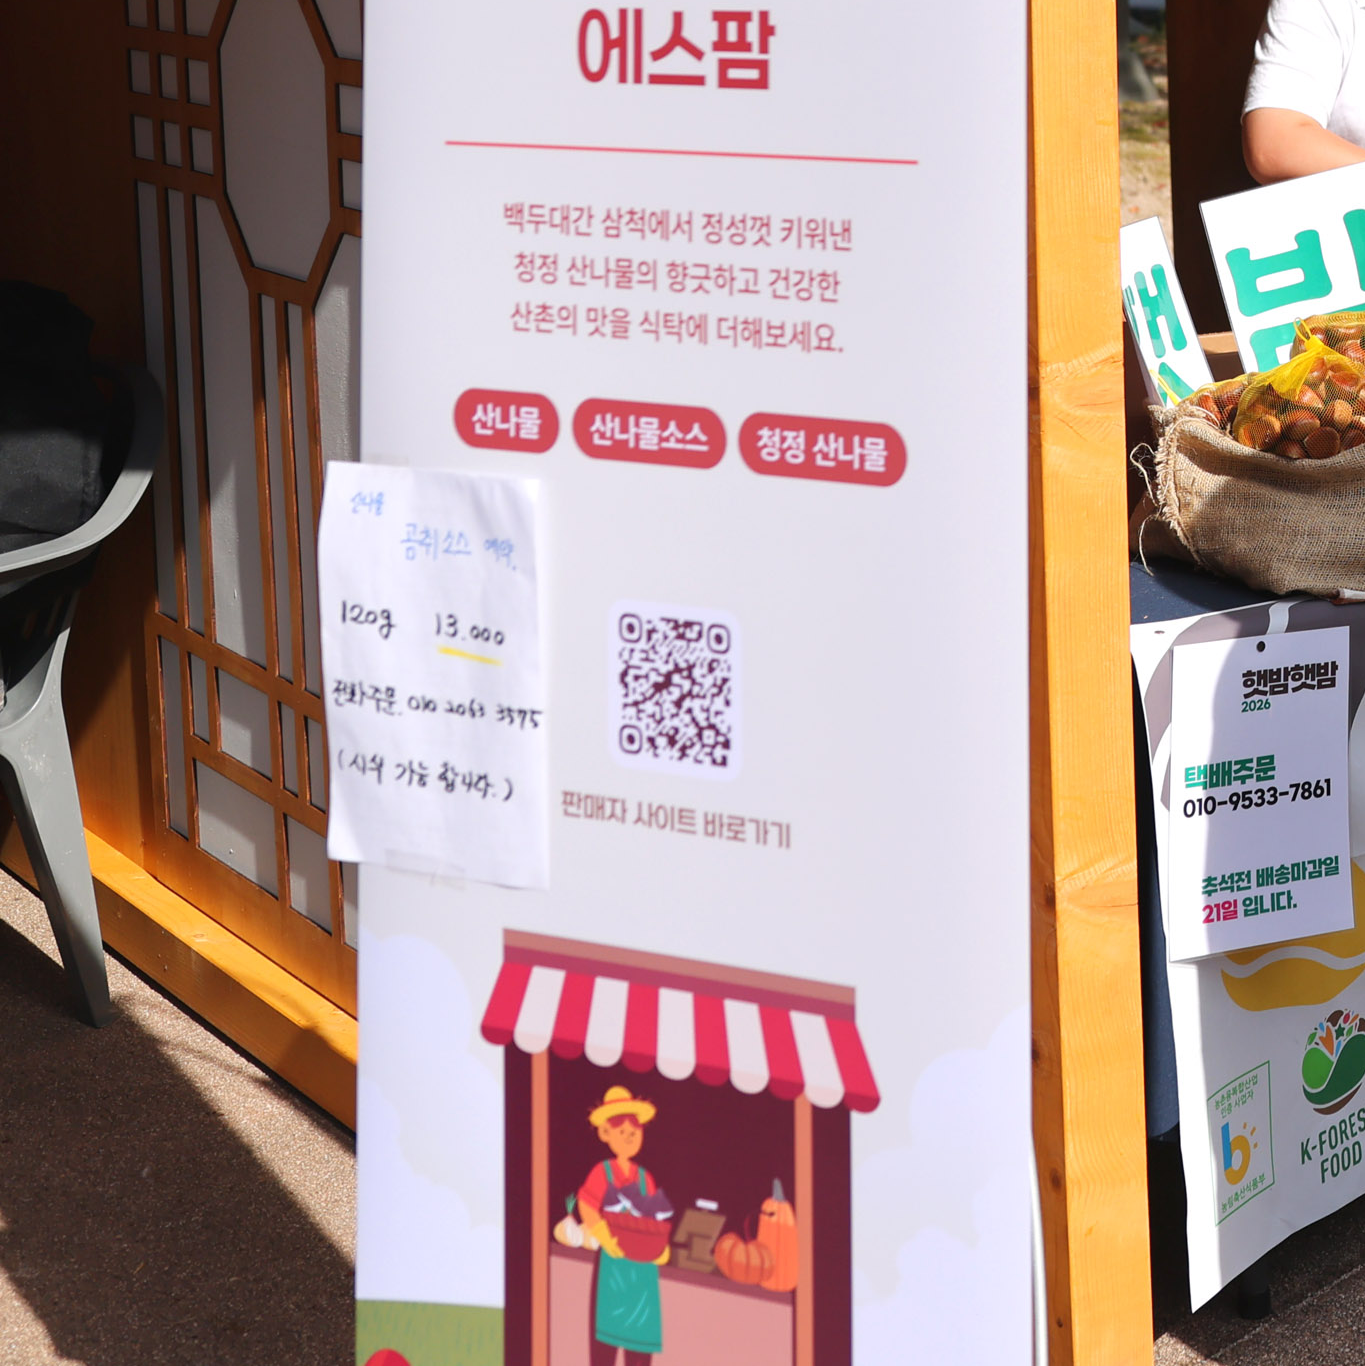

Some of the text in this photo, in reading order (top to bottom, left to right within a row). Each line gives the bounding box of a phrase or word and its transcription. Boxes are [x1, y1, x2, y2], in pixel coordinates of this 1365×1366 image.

[577, 7, 776, 90] 에스팜
[503, 202, 852, 252] 백두대간 삼척에서 정성껏 키워낸
[514, 251, 841, 303] 청정 산나물의 향긋하고 건강한
[510, 301, 844, 353] 산촌의 맛을 식탁에 더해보세요.
[471, 402, 542, 440] 산나물
[588, 412, 710, 453] 산나물소스
[756, 426, 889, 473] 청정 산나물
[341, 600, 396, 641] 120g
[1241, 660, 1339, 700] 햇밤햇밤
[407, 694, 438, 713] 010
[1241, 698, 1271, 713] 2026
[1184, 754, 1277, 790] 택배주문
[1183, 778, 1332, 819] 010-9533-7861
[561, 789, 792, 850] 판매자 사이트 바로가기
[1201, 855, 1340, 897] 추석전 배송마감일
[1202, 889, 1298, 924] 21일 입니다.
[1320, 1140, 1363, 1184] FOOD
